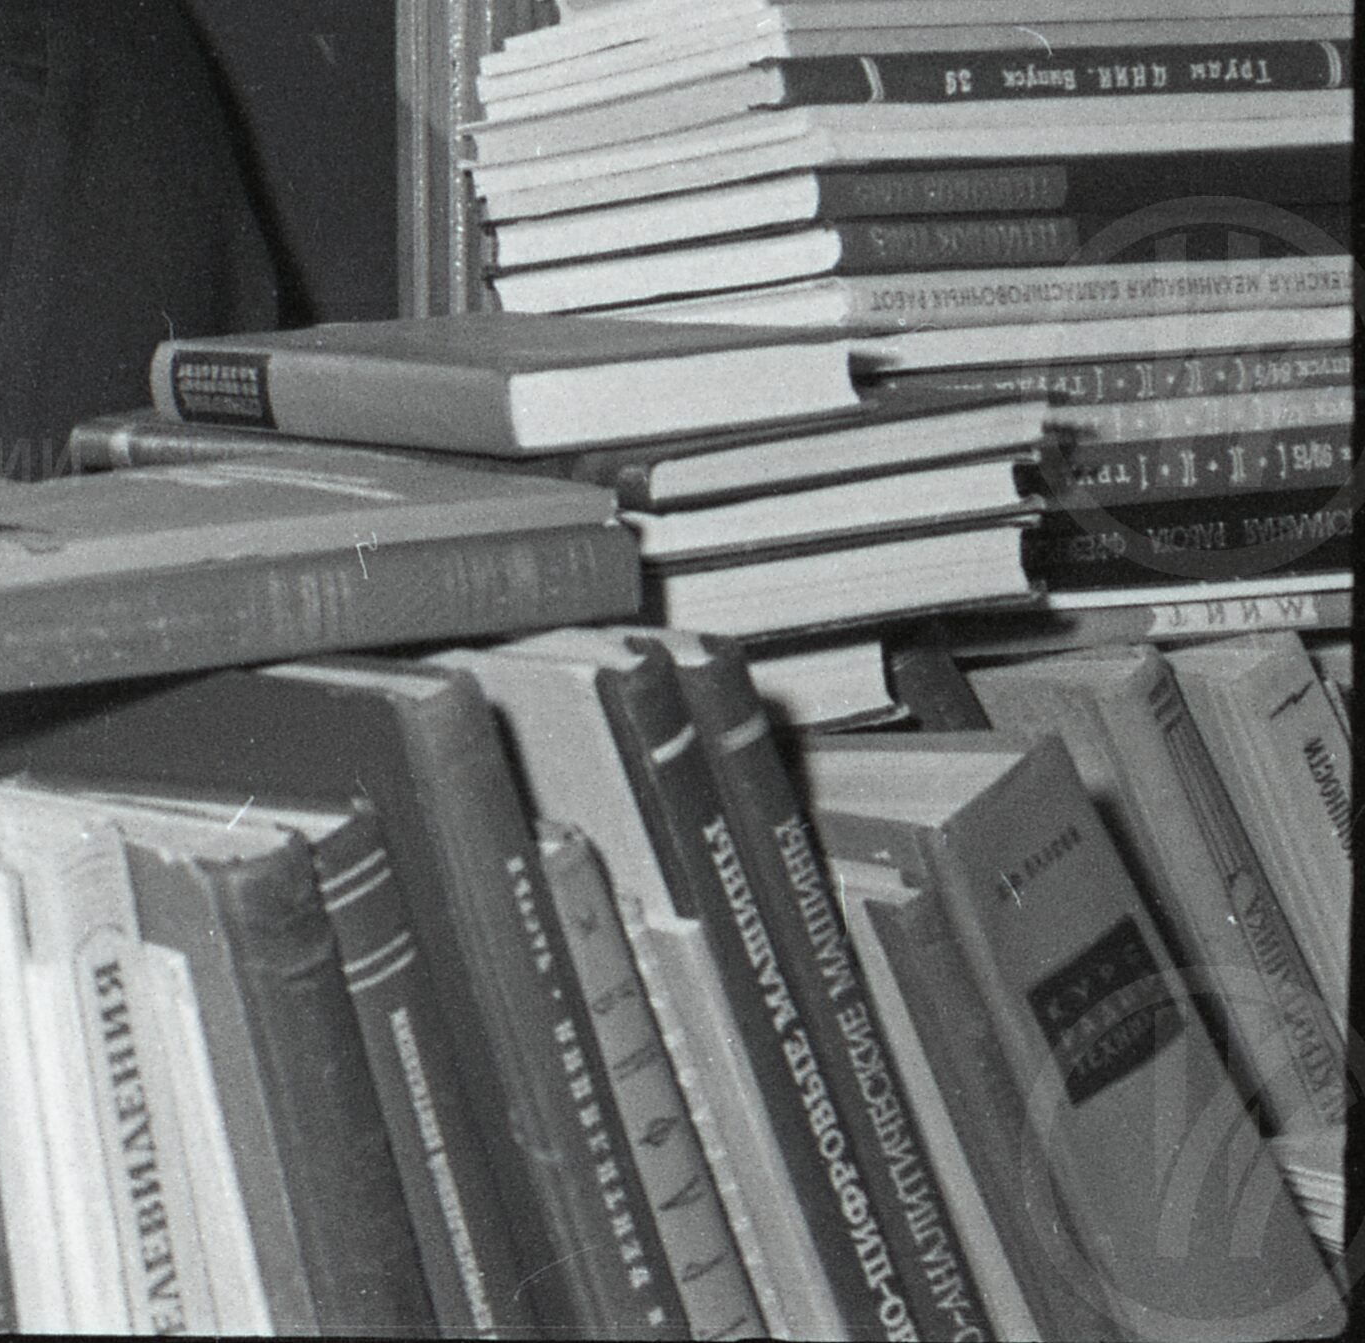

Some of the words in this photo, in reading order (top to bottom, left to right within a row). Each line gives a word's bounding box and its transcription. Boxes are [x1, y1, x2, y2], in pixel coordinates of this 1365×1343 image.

[1003, 62, 1077, 92] Выпуск
[1190, 58, 1273, 84] Труды
[870, 289, 926, 311] РАБОТ
[1126, 274, 1260, 301] МЕХАНИЗАЦИЯ
[769, 812, 859, 1000] МАШИНЫ
[698, 812, 802, 1031] МАШИНЫ
[90, 958, 187, 1335] ЕЛЕВИДЕНИЯ
